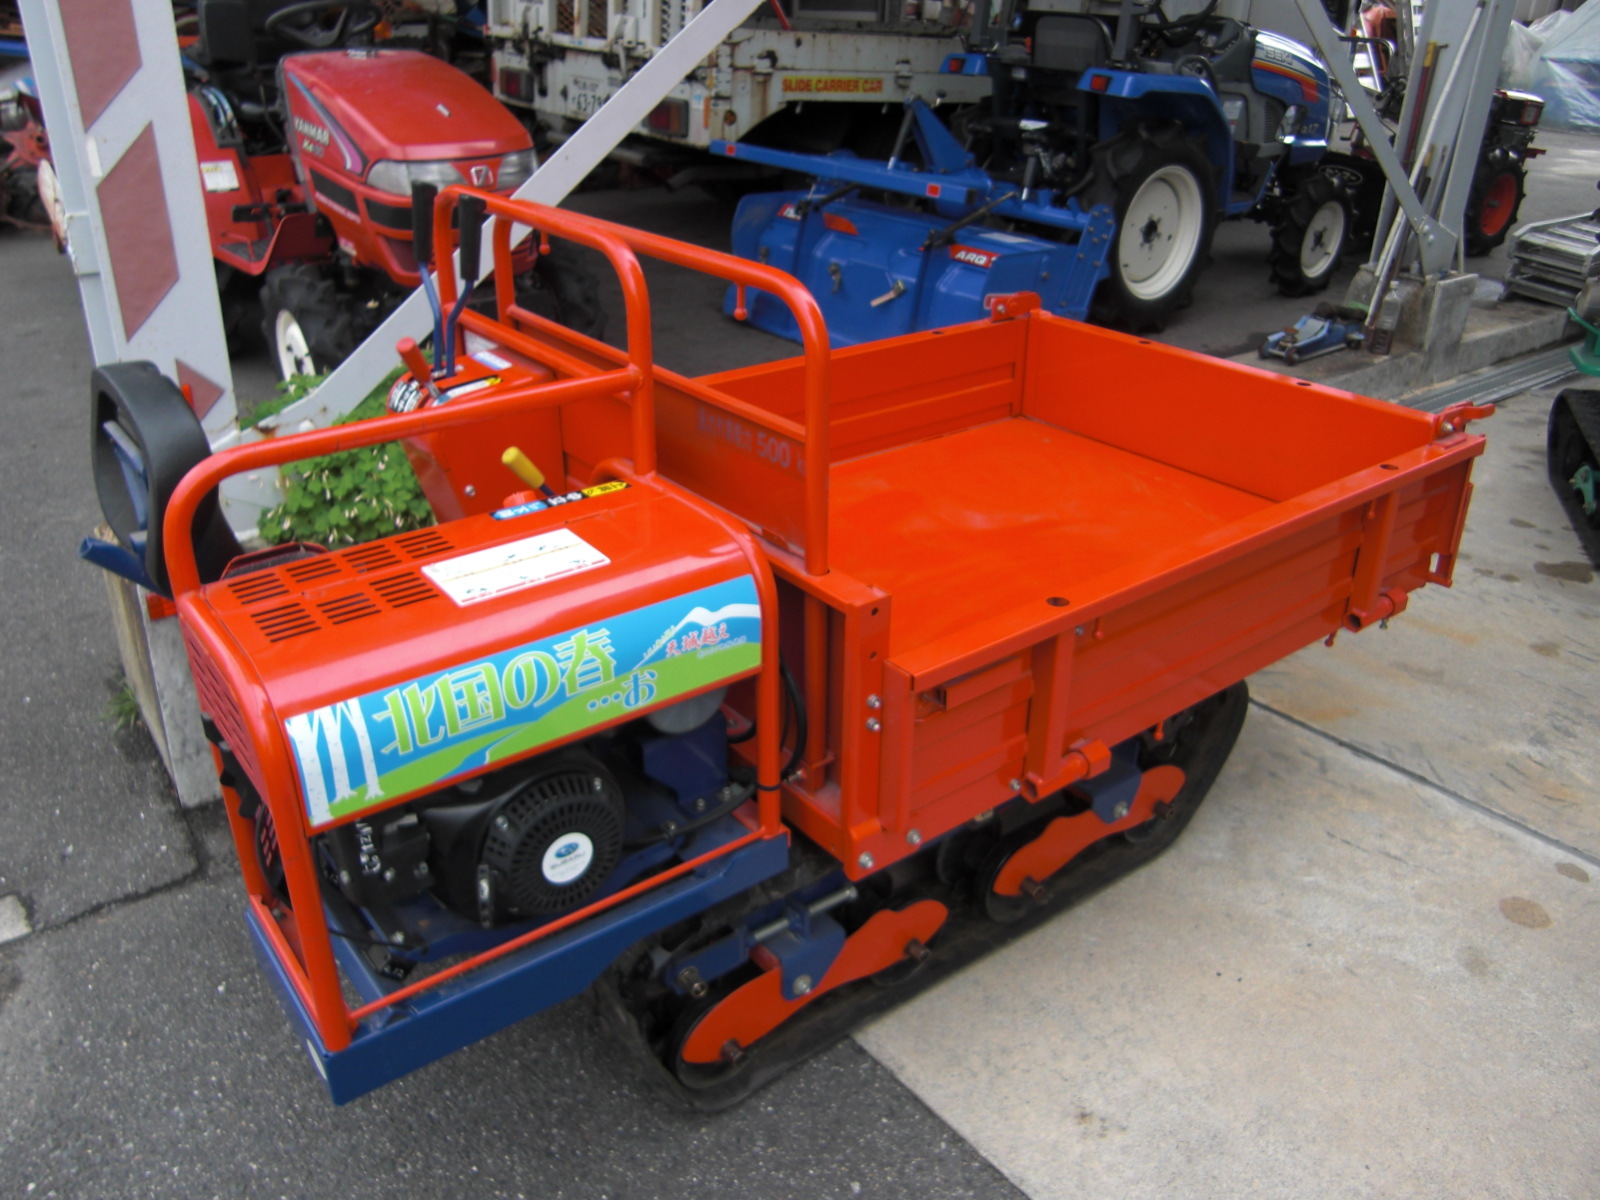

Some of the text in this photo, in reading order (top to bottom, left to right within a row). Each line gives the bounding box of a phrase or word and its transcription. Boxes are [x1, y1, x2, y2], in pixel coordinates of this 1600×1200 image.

[782, 78, 883, 92] SLIDE CARRIER CAR
[293, 115, 331, 147] YANMAR
[756, 430, 792, 469] 500
[666, 621, 730, 658] 天城越え
[371, 627, 618, 756] 北国の春
